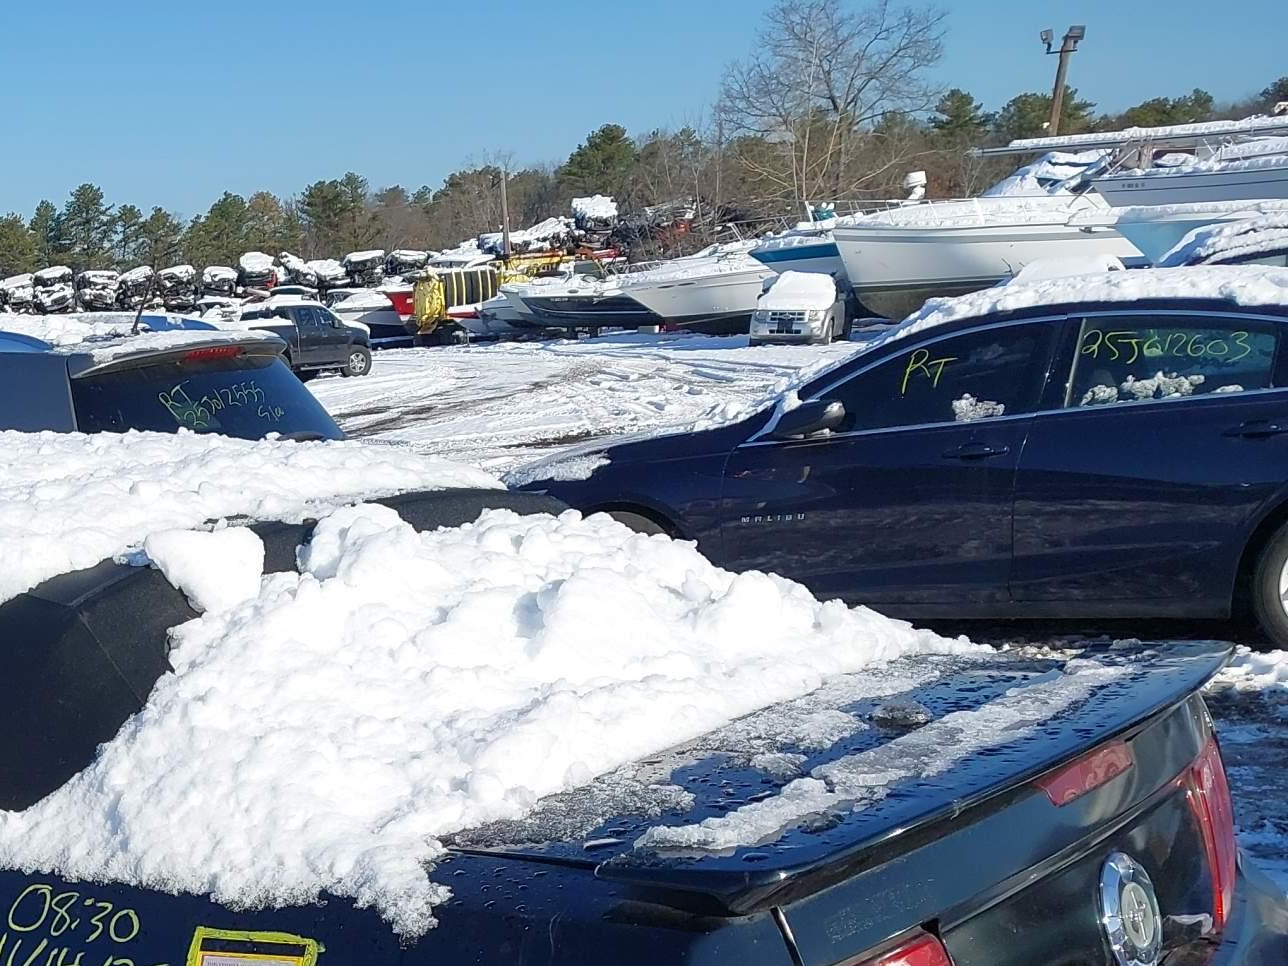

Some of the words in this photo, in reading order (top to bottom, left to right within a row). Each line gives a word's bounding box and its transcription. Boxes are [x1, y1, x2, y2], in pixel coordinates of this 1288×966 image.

[902, 349, 958, 395] RT
[158, 380, 190, 420] RT
[741, 512, 805, 523] MALIBU
[8, 884, 140, 943] 08:30
